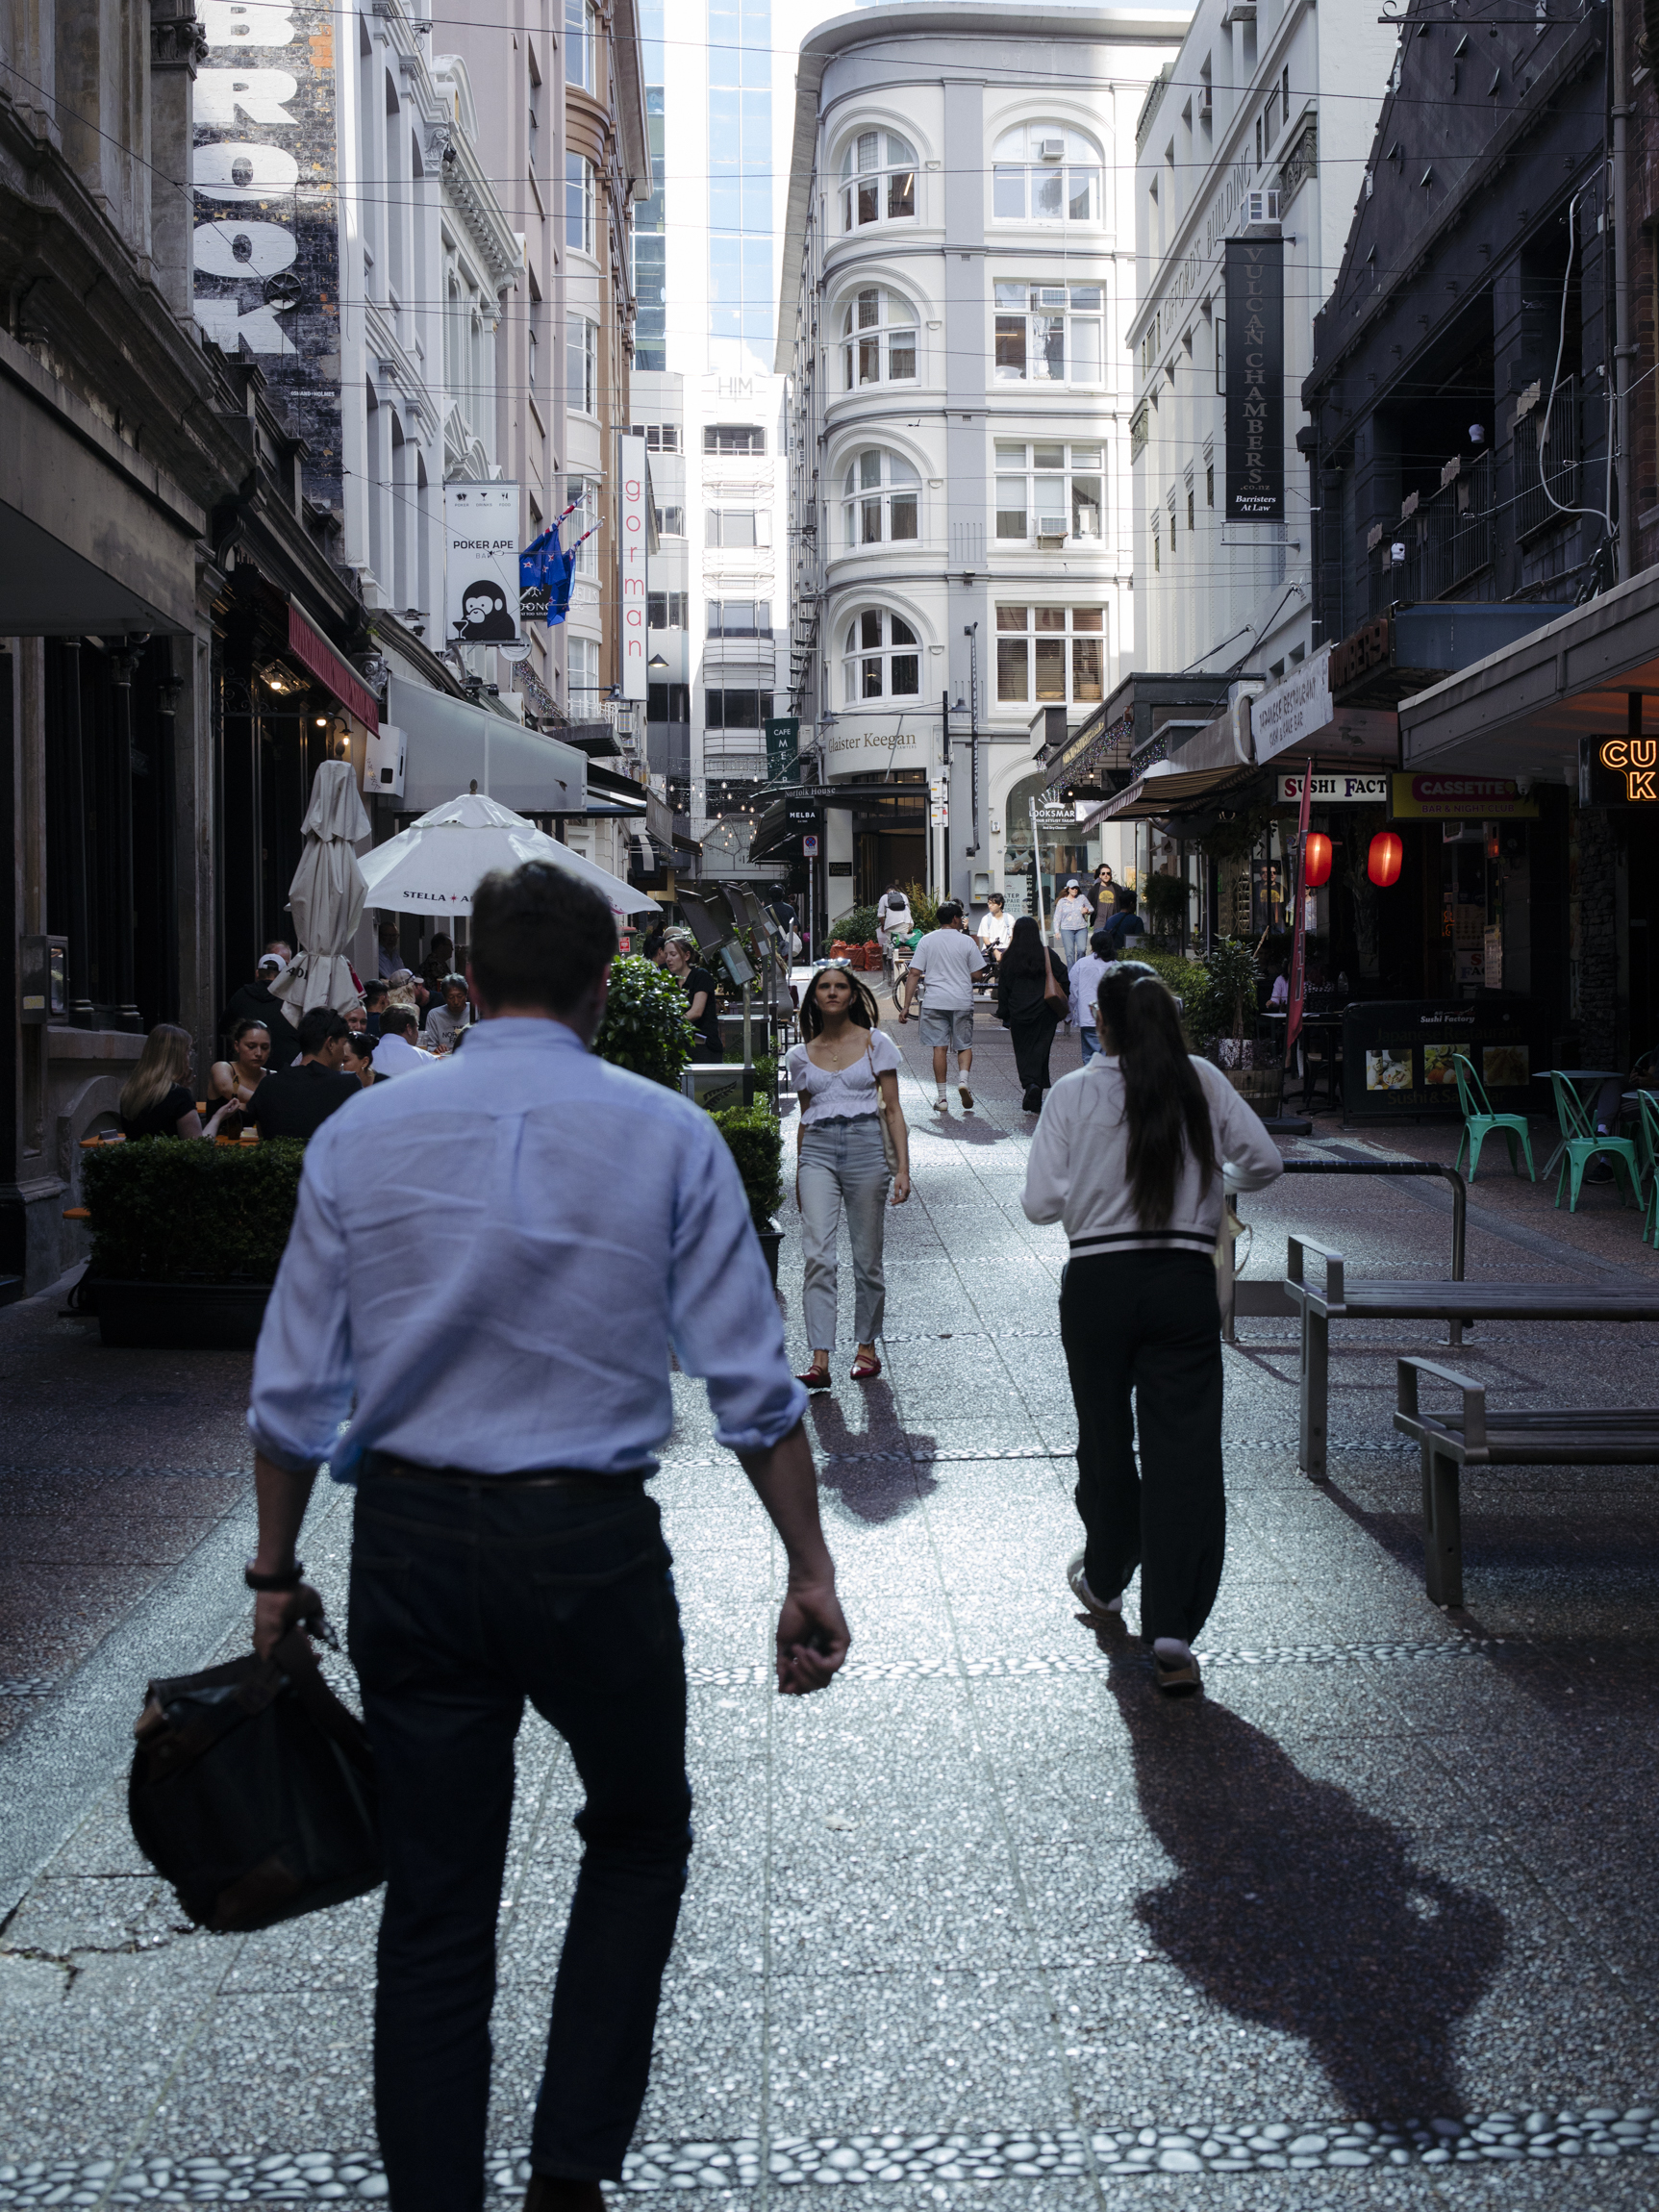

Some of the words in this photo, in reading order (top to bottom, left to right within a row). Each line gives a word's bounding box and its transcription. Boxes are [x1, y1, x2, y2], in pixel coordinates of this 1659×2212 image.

[1164, 237, 1201, 336] GIFFORD'S
[1207, 144, 1251, 260] BUILDING
[1244, 248, 1266, 346] VULCAN
[1242, 352, 1268, 484] CHAMBERS
[1236, 494, 1276, 503] Barristers
[1241, 503, 1252, 512] At
[1252, 503, 1270, 512] Law
[453, 540, 490, 549] POKER
[492, 540, 514, 549] APE
[624, 479, 644, 658] gorman
[773, 728, 792, 737] CAFE
[828, 736, 861, 754] Glaister
[864, 732, 917, 750] Keegan
[784, 788, 810, 798] Norfolk
[811, 787, 837, 796] House
[1420, 781, 1505, 795] CASSETTE
[403, 891, 446, 901] STELLA
[1420, 1015, 1443, 1023] Sushi
[1444, 1015, 1475, 1024] Factory
[1375, 1027, 1442, 1046] Japanese
[1444, 1025, 1521, 1042] Restaurant
[1387, 1090, 1427, 1105] Sushi
[1430, 1092, 1440, 1104] &
